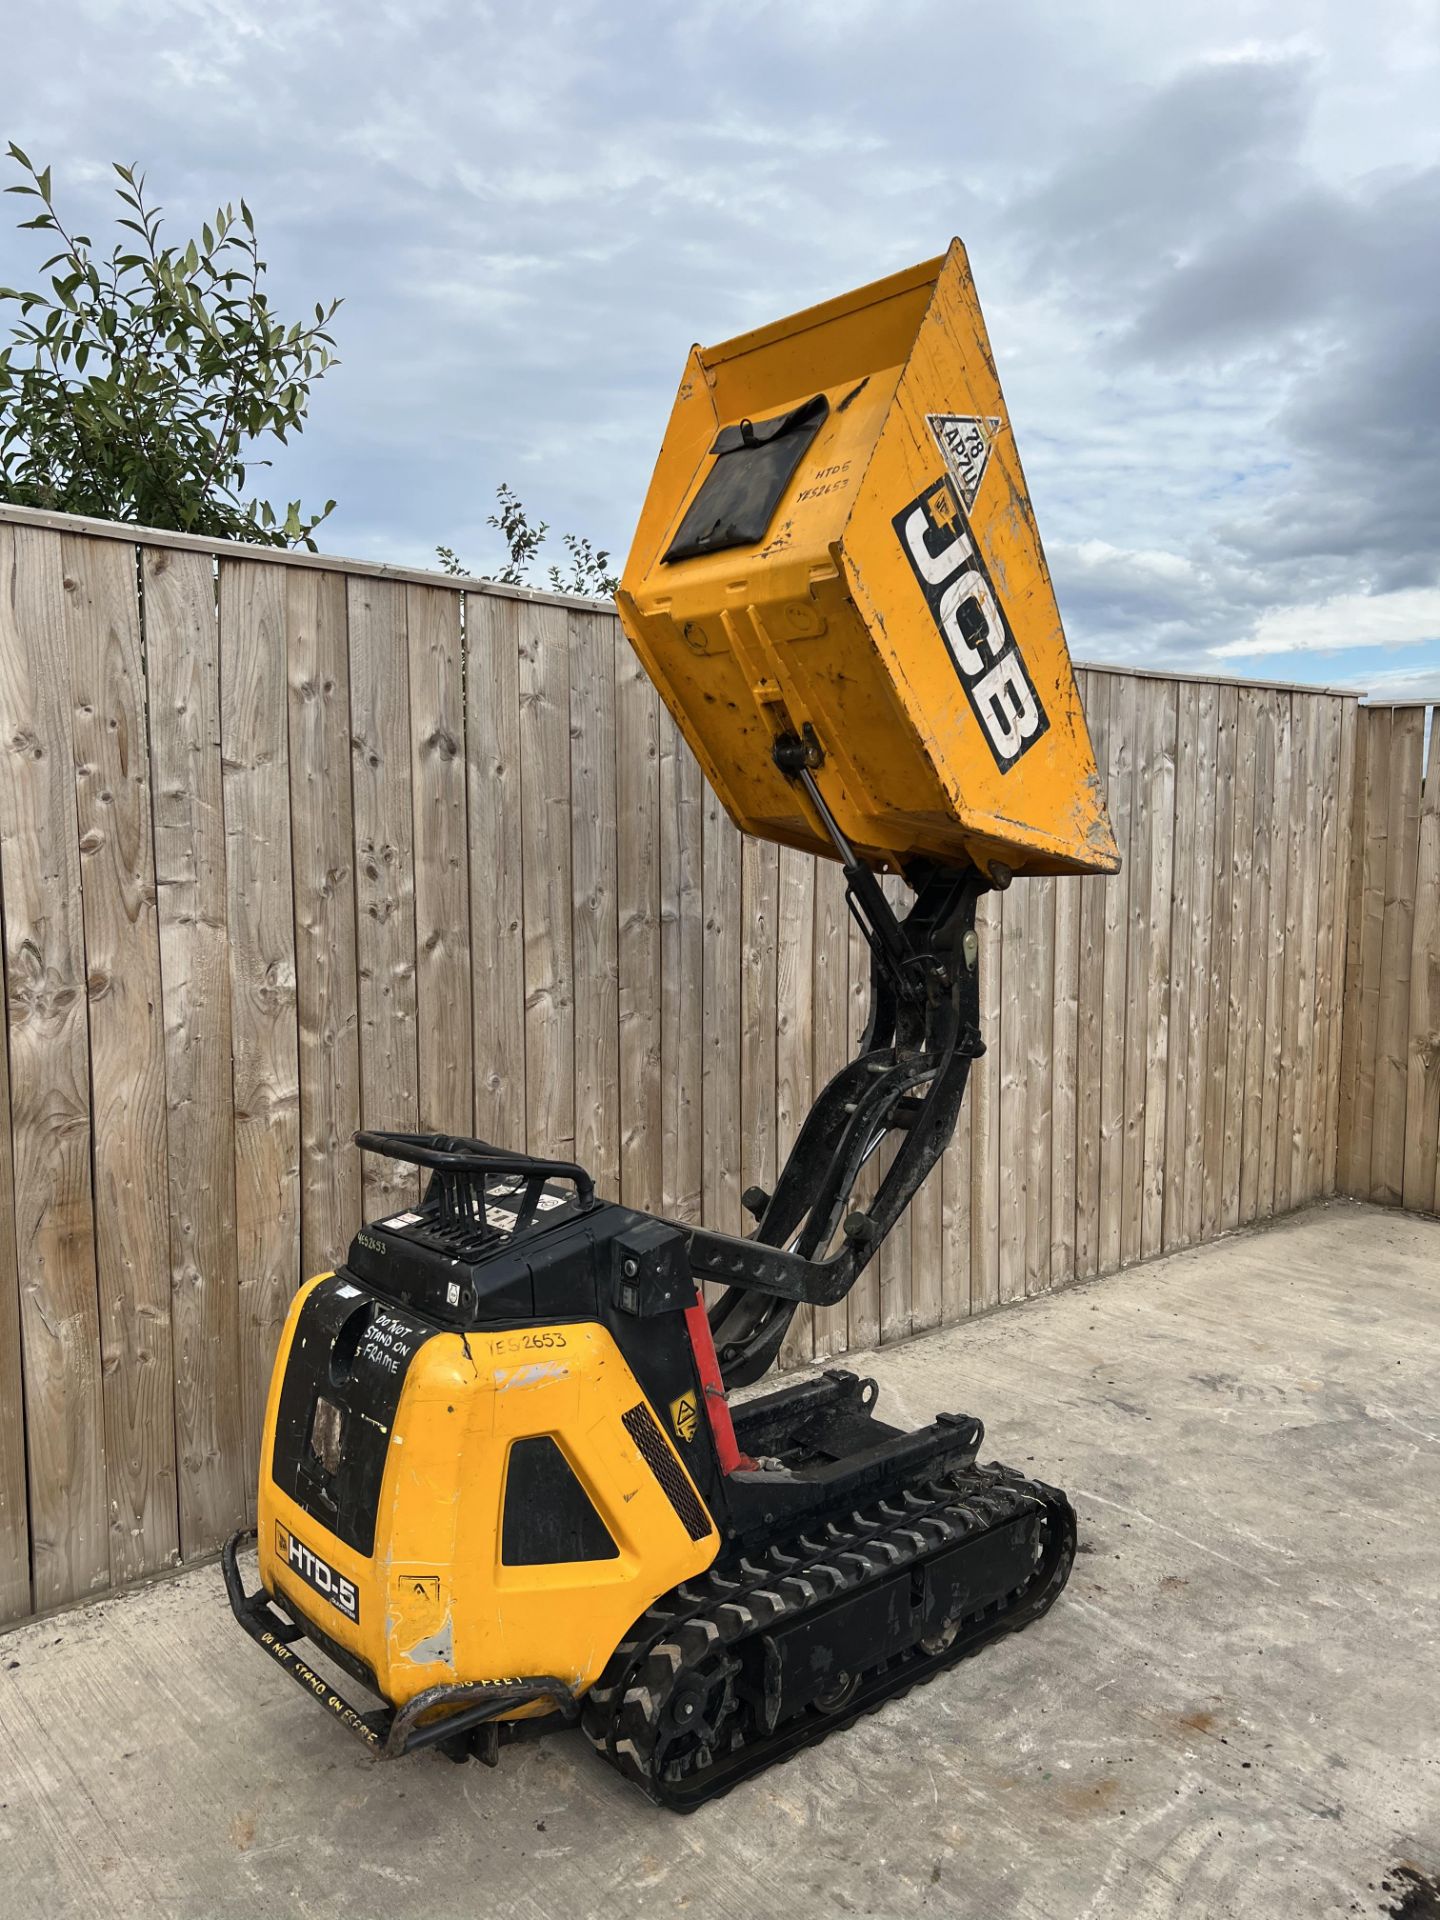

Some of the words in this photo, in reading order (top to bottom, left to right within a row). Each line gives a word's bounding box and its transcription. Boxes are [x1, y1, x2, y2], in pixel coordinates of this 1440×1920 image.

[944, 427, 978, 486] AP7U
[965, 426, 984, 459] 78
[905, 507, 1039, 759] JCB
[364, 1325, 392, 1347] STAND
[392, 1341, 411, 1357] ON
[375, 1315, 391, 1327] DO
[388, 1320, 413, 1338] NOT
[363, 1343, 400, 1374] FRAME
[289, 1535, 355, 1611] HTD-5
[261, 1632, 275, 1645] DO
[272, 1643, 293, 1660] NOT
[328, 1696, 344, 1712] ON
